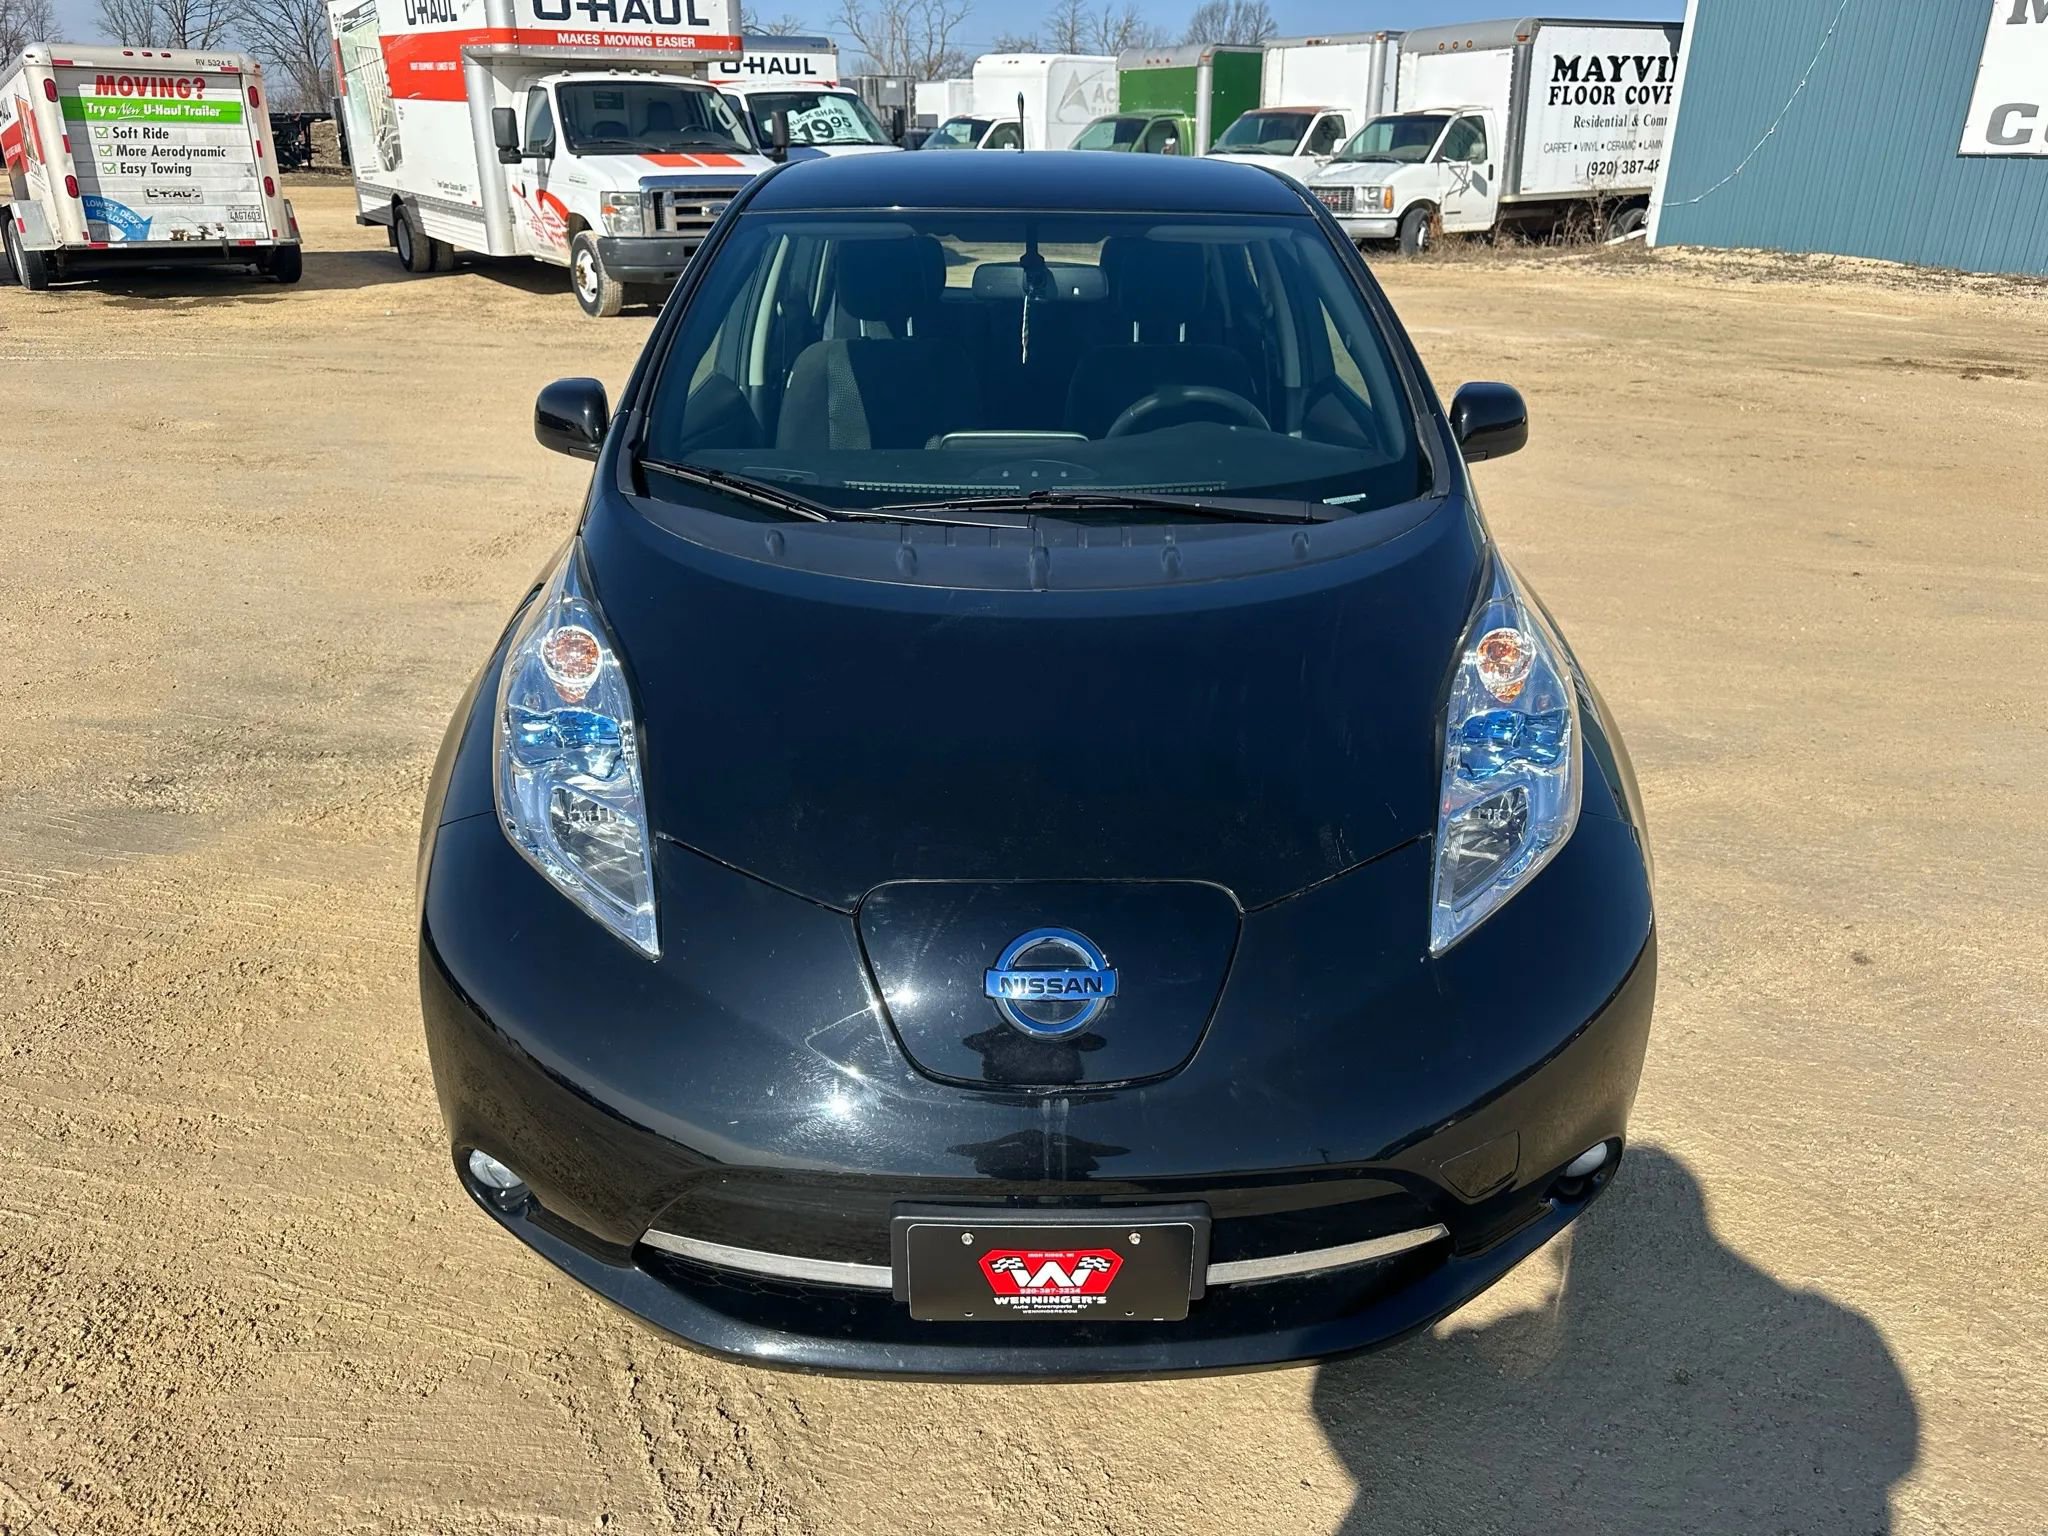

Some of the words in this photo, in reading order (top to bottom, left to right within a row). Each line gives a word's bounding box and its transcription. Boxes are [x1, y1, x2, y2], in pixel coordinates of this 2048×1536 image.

[404, 0, 458, 25] U-HAUL
[533, 0, 710, 26] U-HAUL
[557, 32, 600, 45] MAKES
[604, 34, 652, 47] MOVING
[655, 36, 696, 48] EASIER
[195, 58, 205, 66] RV
[720, 56, 817, 75] U-HAUL
[95, 74, 206, 100] MOVING?
[1548, 85, 1615, 106] FLOOR
[86, 102, 107, 115] Try
[108, 106, 117, 114] a
[117, 103, 141, 116] New
[143, 105, 182, 116] U-Haul
[184, 105, 221, 117] Trailer
[1573, 114, 1628, 129] Residential
[1631, 114, 1639, 127] &
[112, 126, 138, 139] Soft
[143, 127, 169, 139] Ride
[116, 145, 147, 157] More
[151, 145, 227, 160] Aerodynamic
[1543, 142, 1572, 153] CARPET
[1580, 141, 1599, 152] VINYL
[1606, 140, 1637, 151] CERAMIC
[120, 162, 147, 176] Easy
[151, 162, 192, 177] Towing
[1586, 161, 1619, 179] (920)
[85, 199, 119, 213] LOWEST
[1000, 977, 1102, 994] NISSAN
[993, 1296, 1107, 1305] WENNINGER'S
